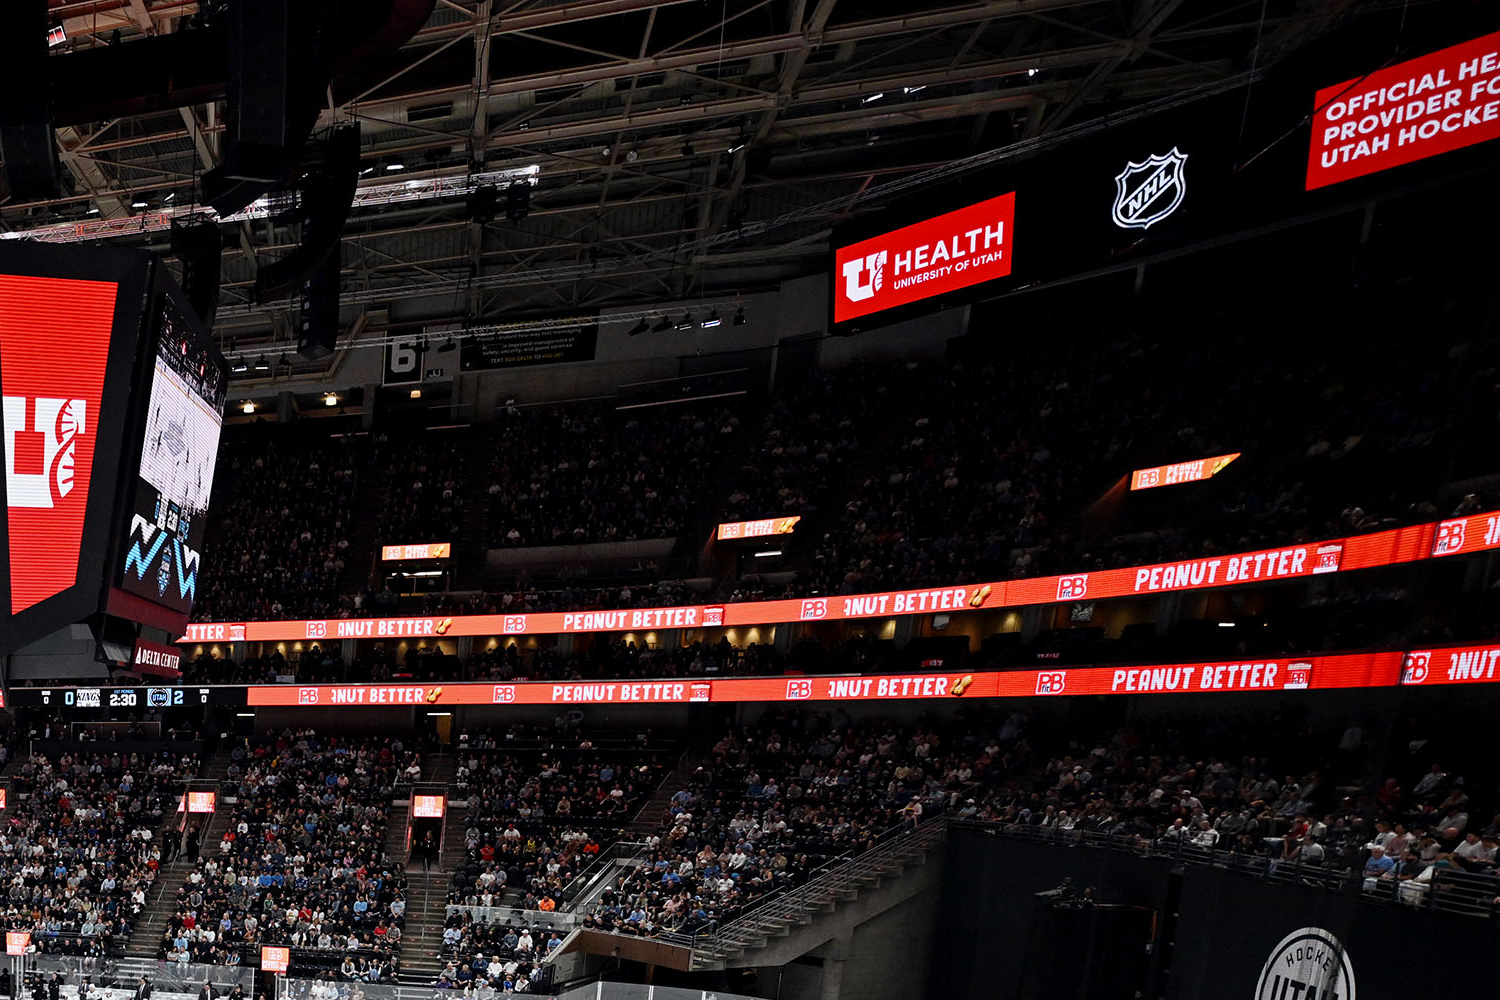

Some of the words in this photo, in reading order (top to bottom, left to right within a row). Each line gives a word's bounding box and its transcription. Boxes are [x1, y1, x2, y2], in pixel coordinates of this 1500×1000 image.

[1325, 68, 1451, 122] OFFICIAL
[1323, 89, 1462, 146] PROVIDER
[1321, 134, 1390, 169] UTAH
[1127, 167, 1174, 217] NHL
[894, 221, 1004, 276] HEALTH
[894, 263, 953, 290] UNIVERSITY
[955, 260, 970, 273] OF
[972, 250, 1003, 268] UTAH
[391, 337, 417, 373] 6
[1165, 461, 1205, 478] PEANUT
[1165, 468, 1204, 484] BETTER
[1134, 561, 1218, 592] PEANUT
[1226, 549, 1307, 583] BETTER
[894, 589, 967, 613] BETTER
[378, 619, 433, 636] BETTER
[564, 612, 628, 631] PEANUT
[632, 608, 696, 629] BETTER
[141, 647, 160, 665] DELTA
[161, 652, 180, 669] CENTER
[877, 677, 948, 696] BETTER
[1111, 666, 1195, 692] PEANUT
[1200, 663, 1278, 689] BETTER
[65, 692, 74, 705] 0
[109, 693, 137, 706] 2:30
[174, 691, 184, 705] 2
[370, 687, 424, 703] BETTER
[552, 685, 615, 703] PEANUT
[618, 684, 684, 702] BETTER
